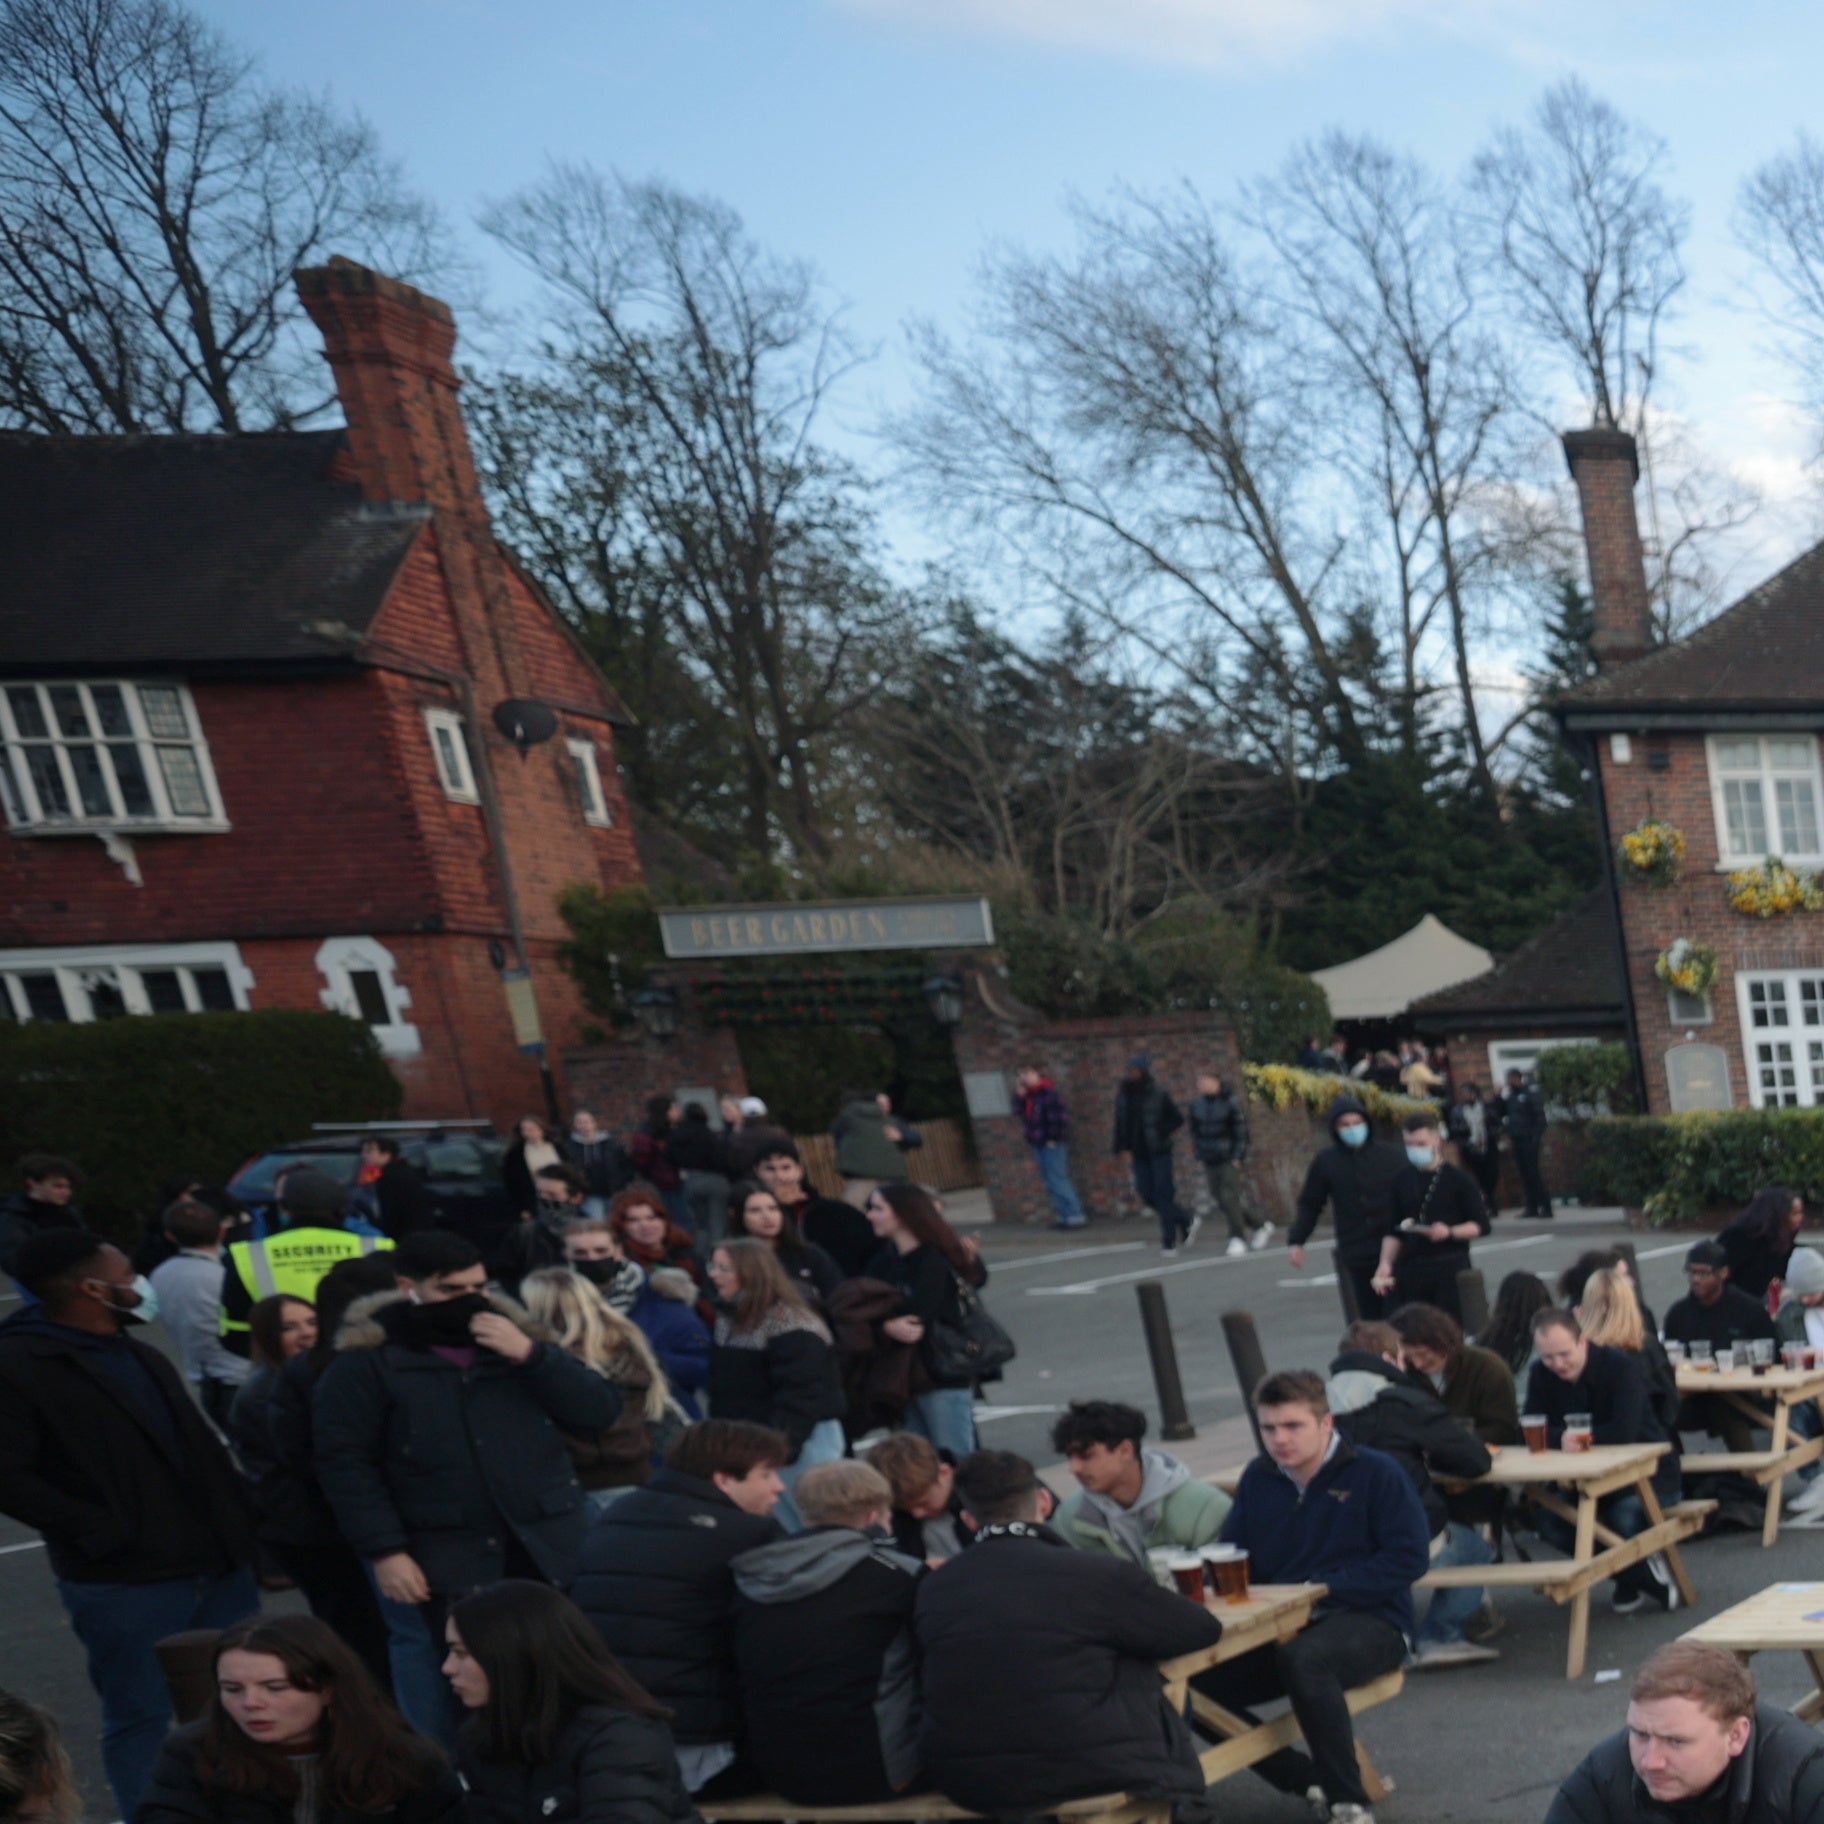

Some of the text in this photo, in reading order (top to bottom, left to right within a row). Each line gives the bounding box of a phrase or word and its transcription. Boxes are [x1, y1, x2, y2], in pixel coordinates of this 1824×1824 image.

[691, 916, 764, 947] BEER
[771, 910, 888, 945] GARDEN
[271, 1244, 353, 1259] SECURITY
